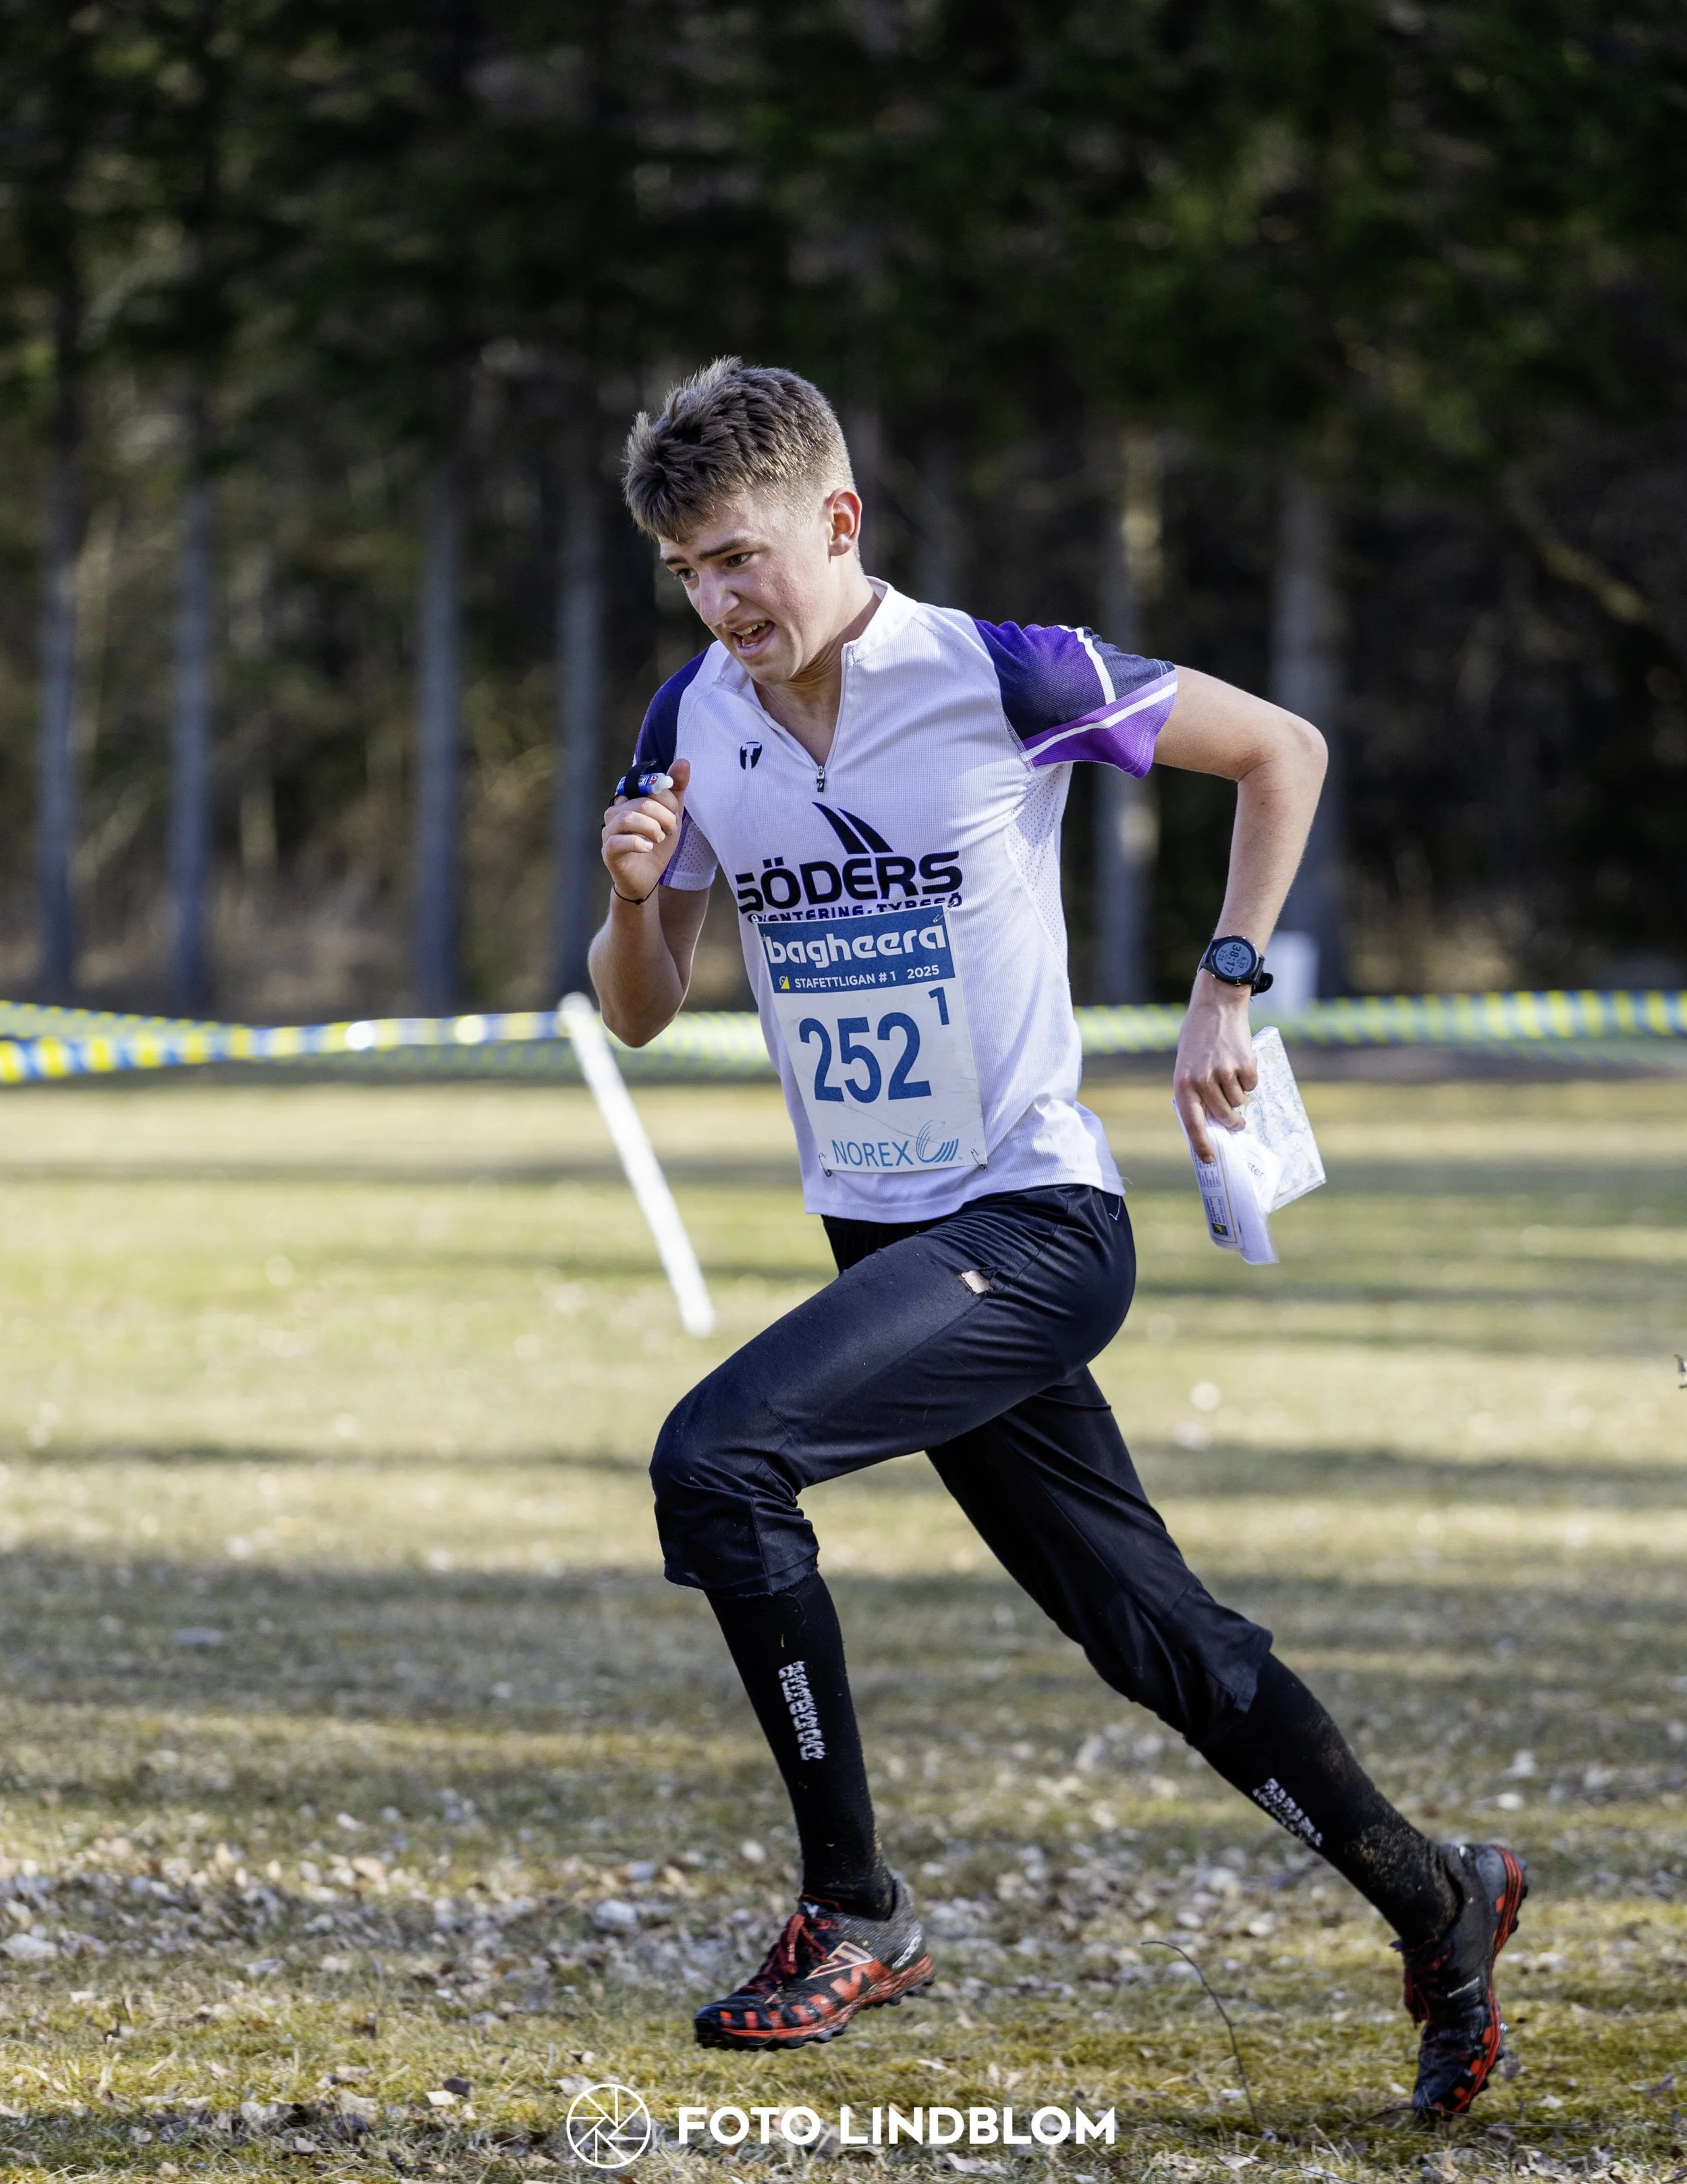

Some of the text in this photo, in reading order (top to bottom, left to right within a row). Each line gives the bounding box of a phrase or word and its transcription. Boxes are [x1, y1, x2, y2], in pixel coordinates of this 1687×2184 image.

[735, 851, 963, 914] SÖDERS
[766, 925, 946, 968] bagheera
[1224, 944, 1242, 974] 38:17
[794, 975, 876, 989] STAFETTLIGAN
[906, 964, 940, 979] 2025
[928, 987, 950, 1025] 1
[798, 1012, 932, 1103] 252
[831, 1139, 914, 1167] NOREX
